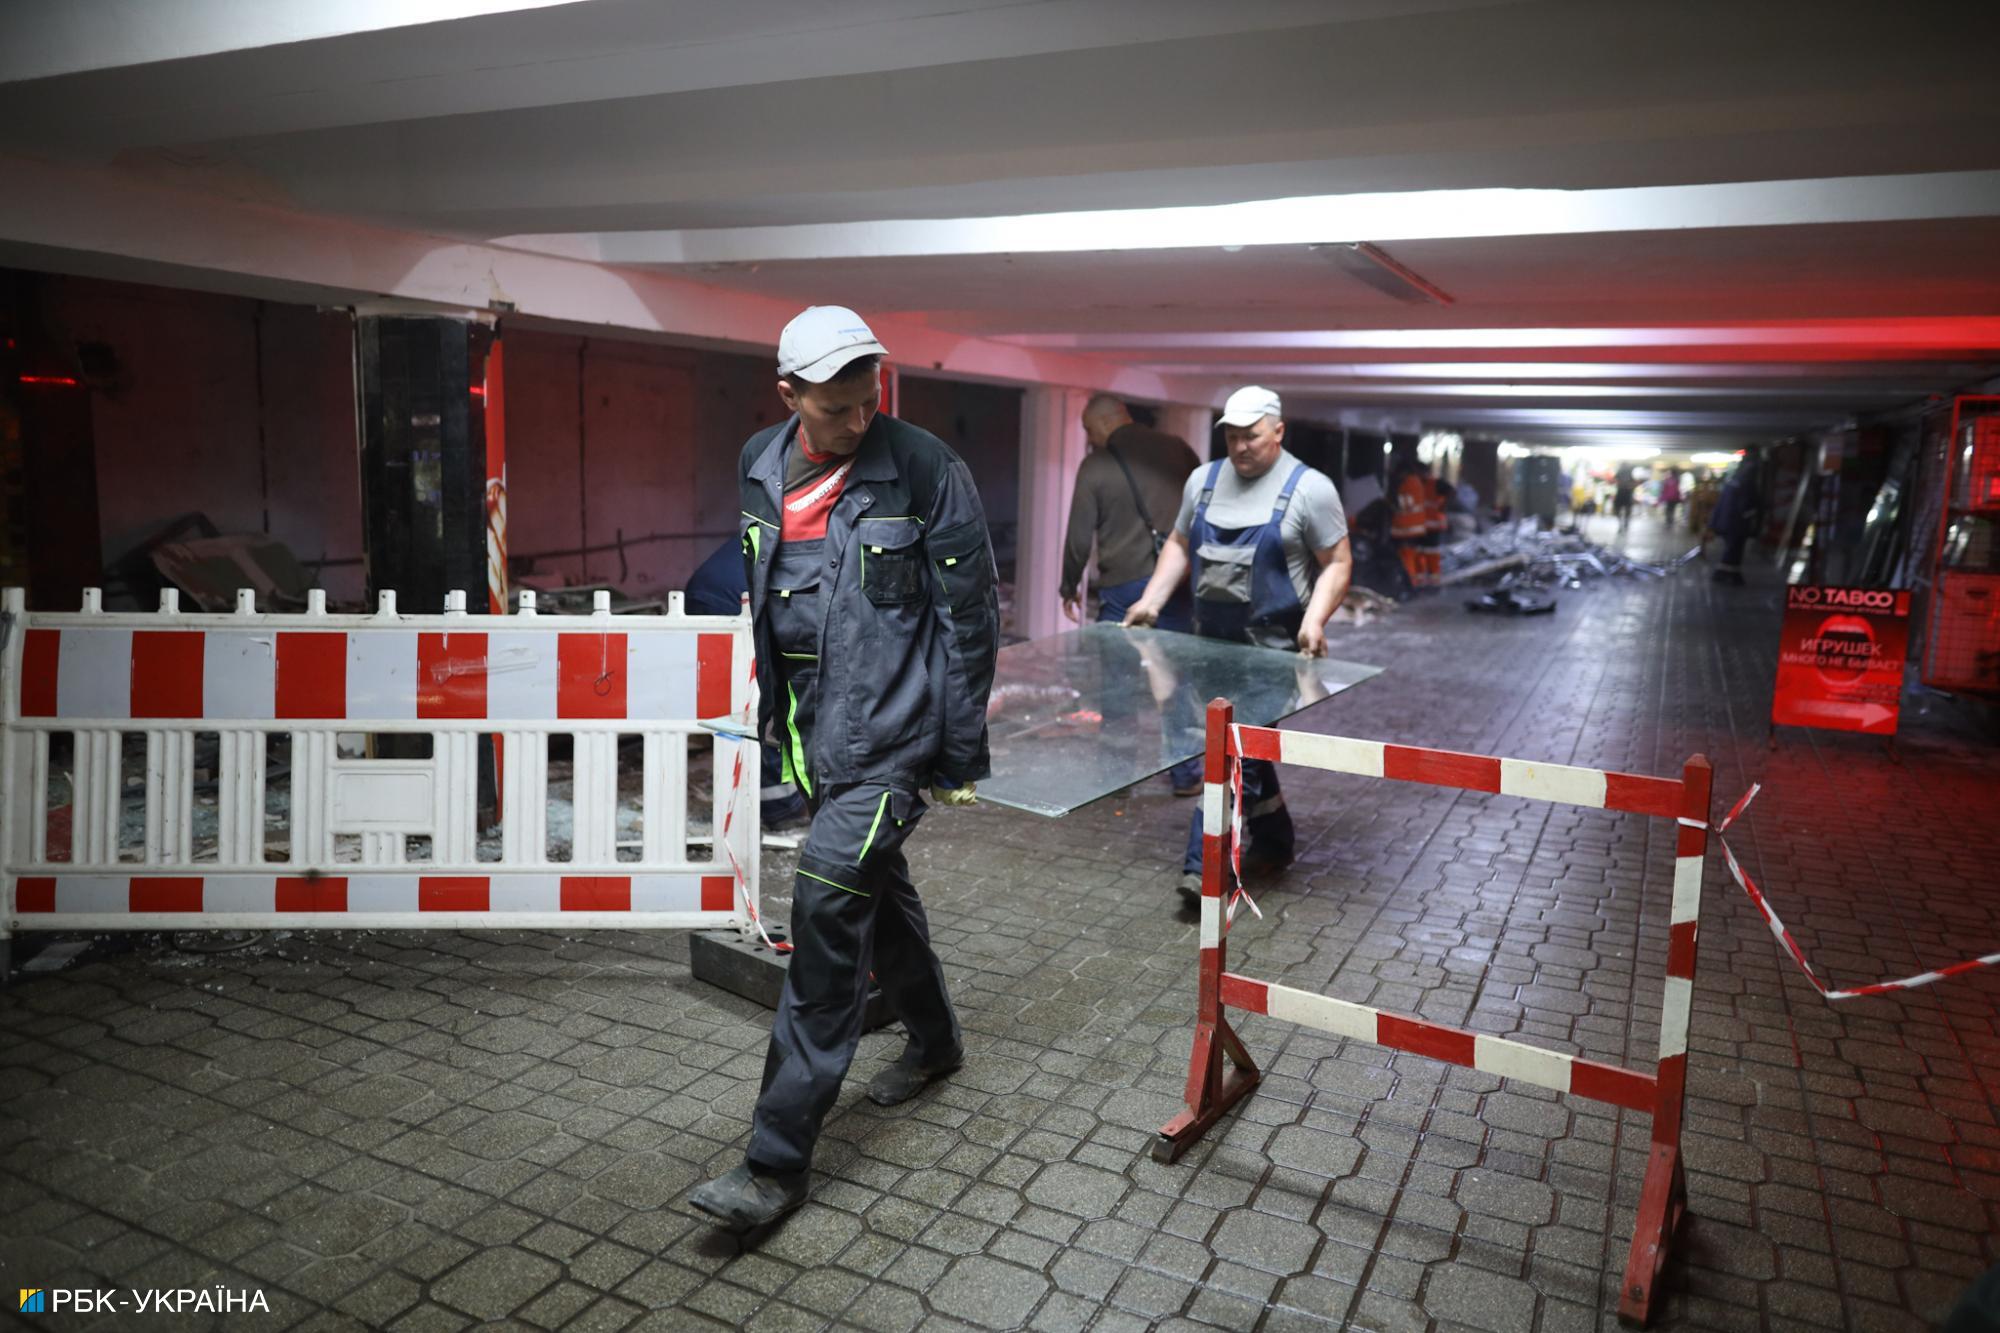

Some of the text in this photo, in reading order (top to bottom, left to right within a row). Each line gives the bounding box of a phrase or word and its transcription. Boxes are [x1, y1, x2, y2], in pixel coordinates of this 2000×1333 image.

[1789, 586, 1893, 607] NO TABOO
[1801, 638, 1882, 655] ИГРУШЕК
